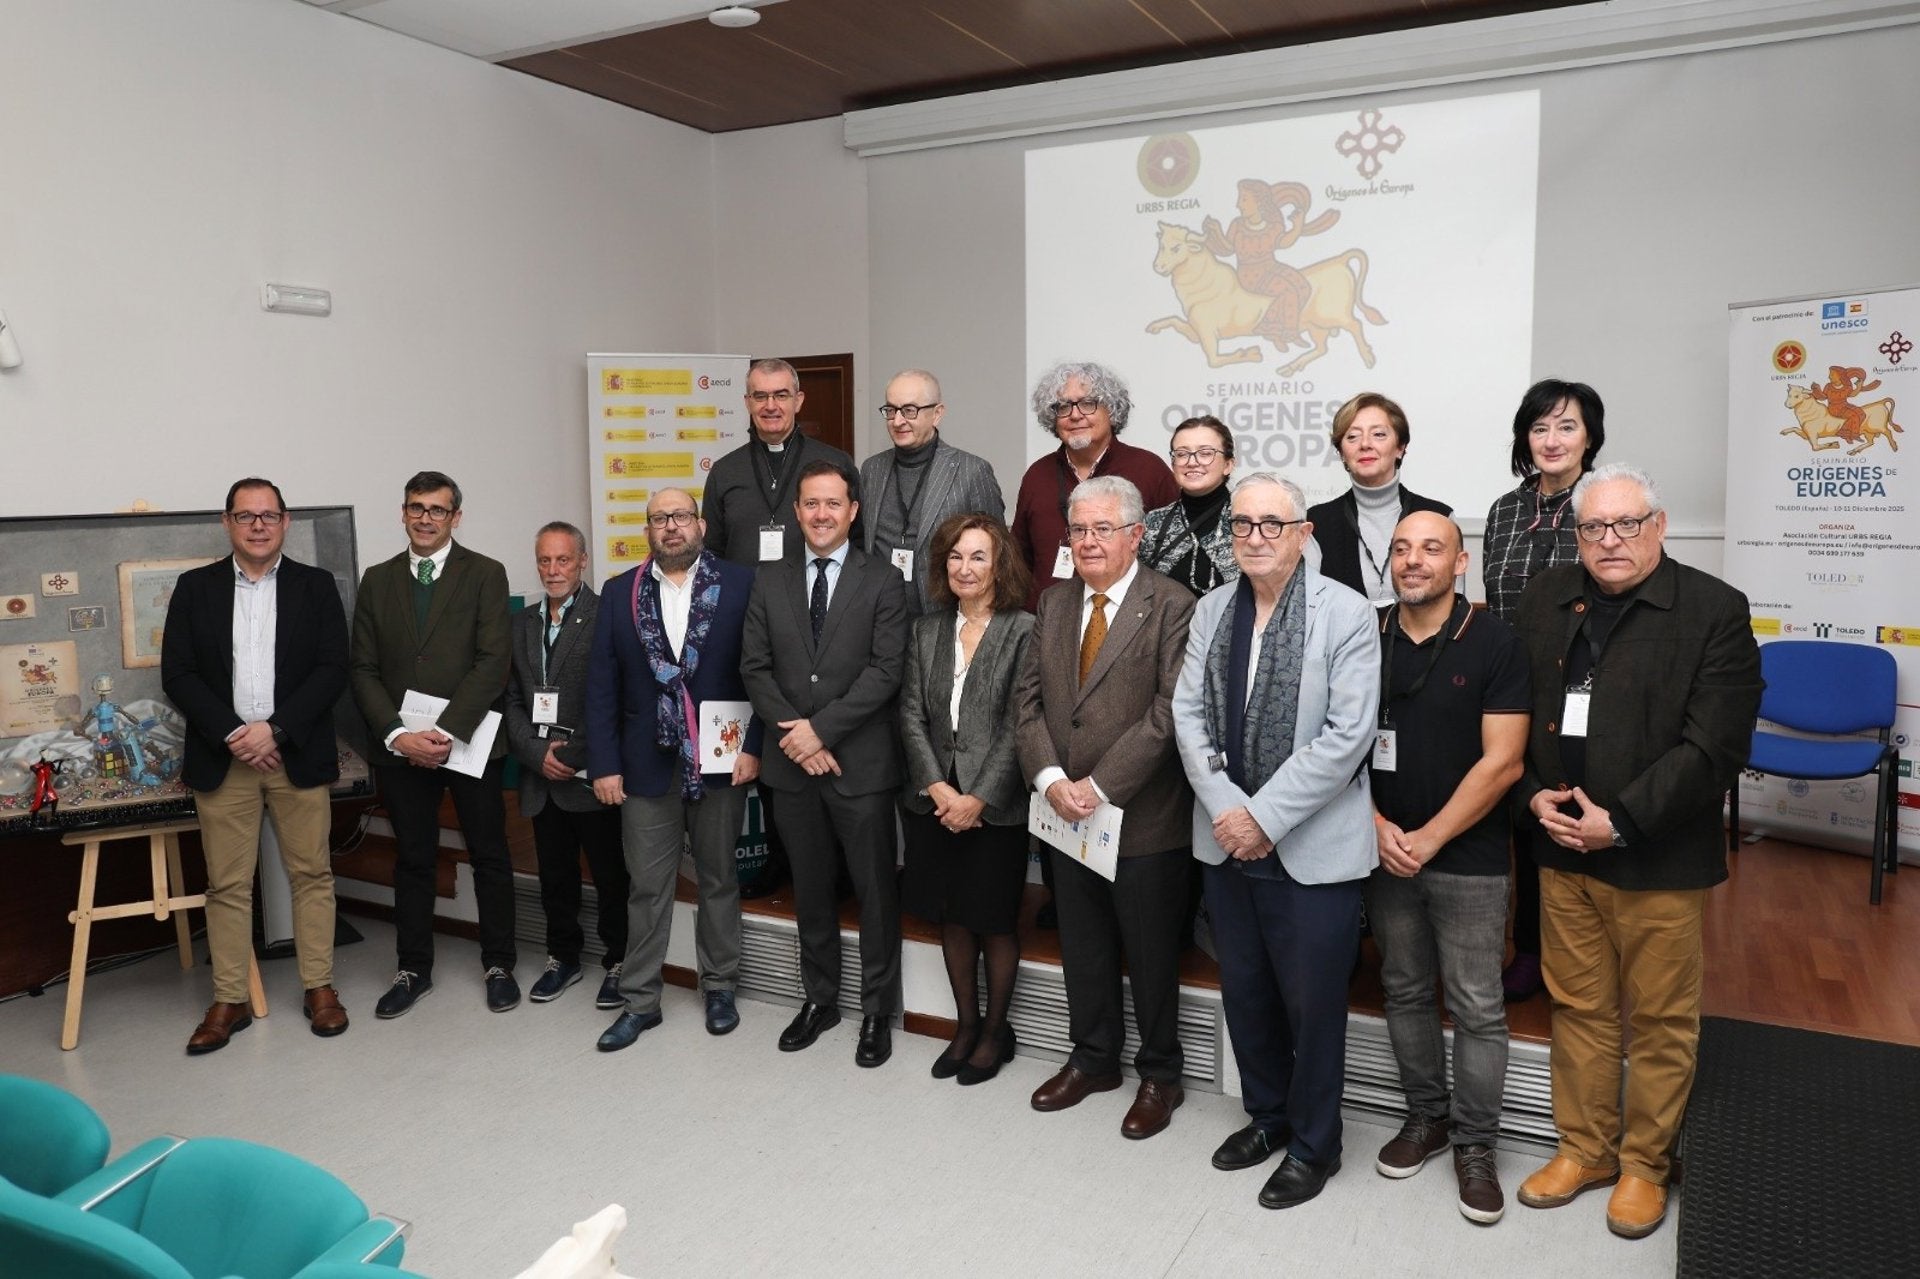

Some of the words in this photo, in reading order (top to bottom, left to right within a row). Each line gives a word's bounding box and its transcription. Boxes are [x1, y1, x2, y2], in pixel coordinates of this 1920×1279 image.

[1136, 201, 1164, 214] URBS
[1167, 198, 1200, 210] REGIA
[1822, 318, 1868, 330] unesco
[711, 378, 731, 386] aecid
[1206, 380, 1315, 398] SEMINARIO
[1233, 433, 1341, 468] ROPA
[1811, 457, 1867, 465] SEMINARIO
[1787, 464, 1883, 481] ORÍGENES
[1797, 481, 1886, 497] EUROPA
[1835, 627, 1865, 635] TOLEDO
